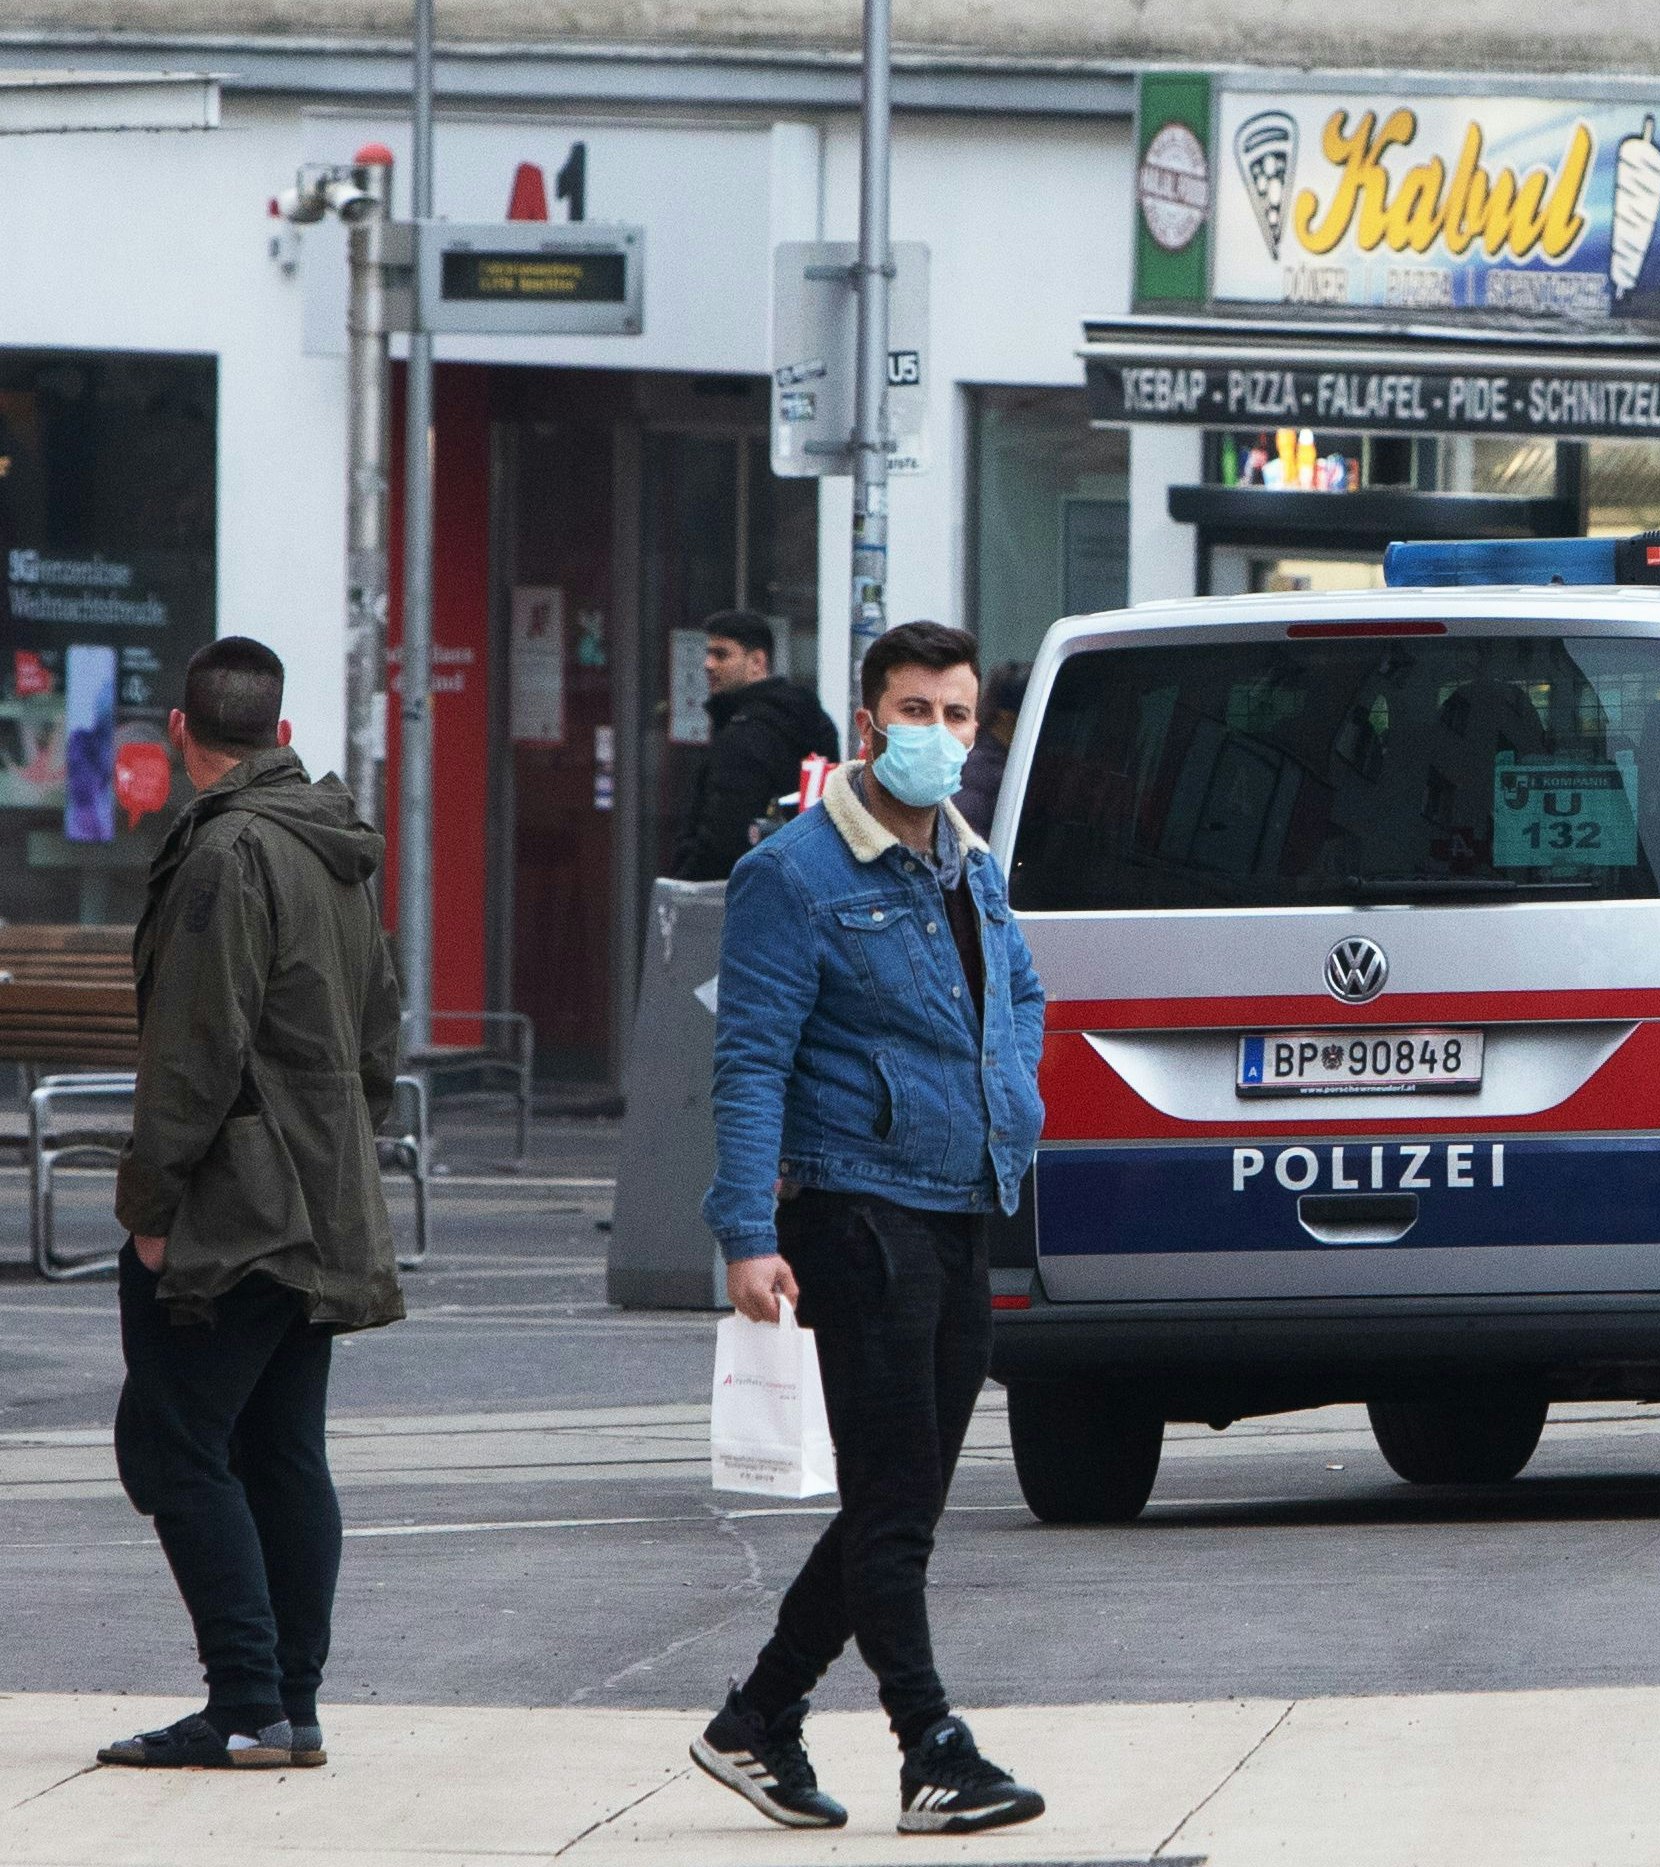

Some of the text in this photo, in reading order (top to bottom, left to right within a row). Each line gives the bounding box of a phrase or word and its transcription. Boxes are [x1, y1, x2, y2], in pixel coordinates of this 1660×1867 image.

[1294, 108, 1593, 256] Kabul
[1121, 367, 1207, 412] KEBAP
[1227, 369, 1299, 414] PIZZA
[1316, 373, 1428, 420] FALAFEL
[1449, 376, 1508, 421] PIDE
[1542, 792, 1582, 817] U
[1521, 821, 1601, 849] 132
[1248, 1066, 1258, 1078] A
[1348, 1039, 1463, 1076] 90848
[1232, 1144, 1504, 1191] POLIZEI
